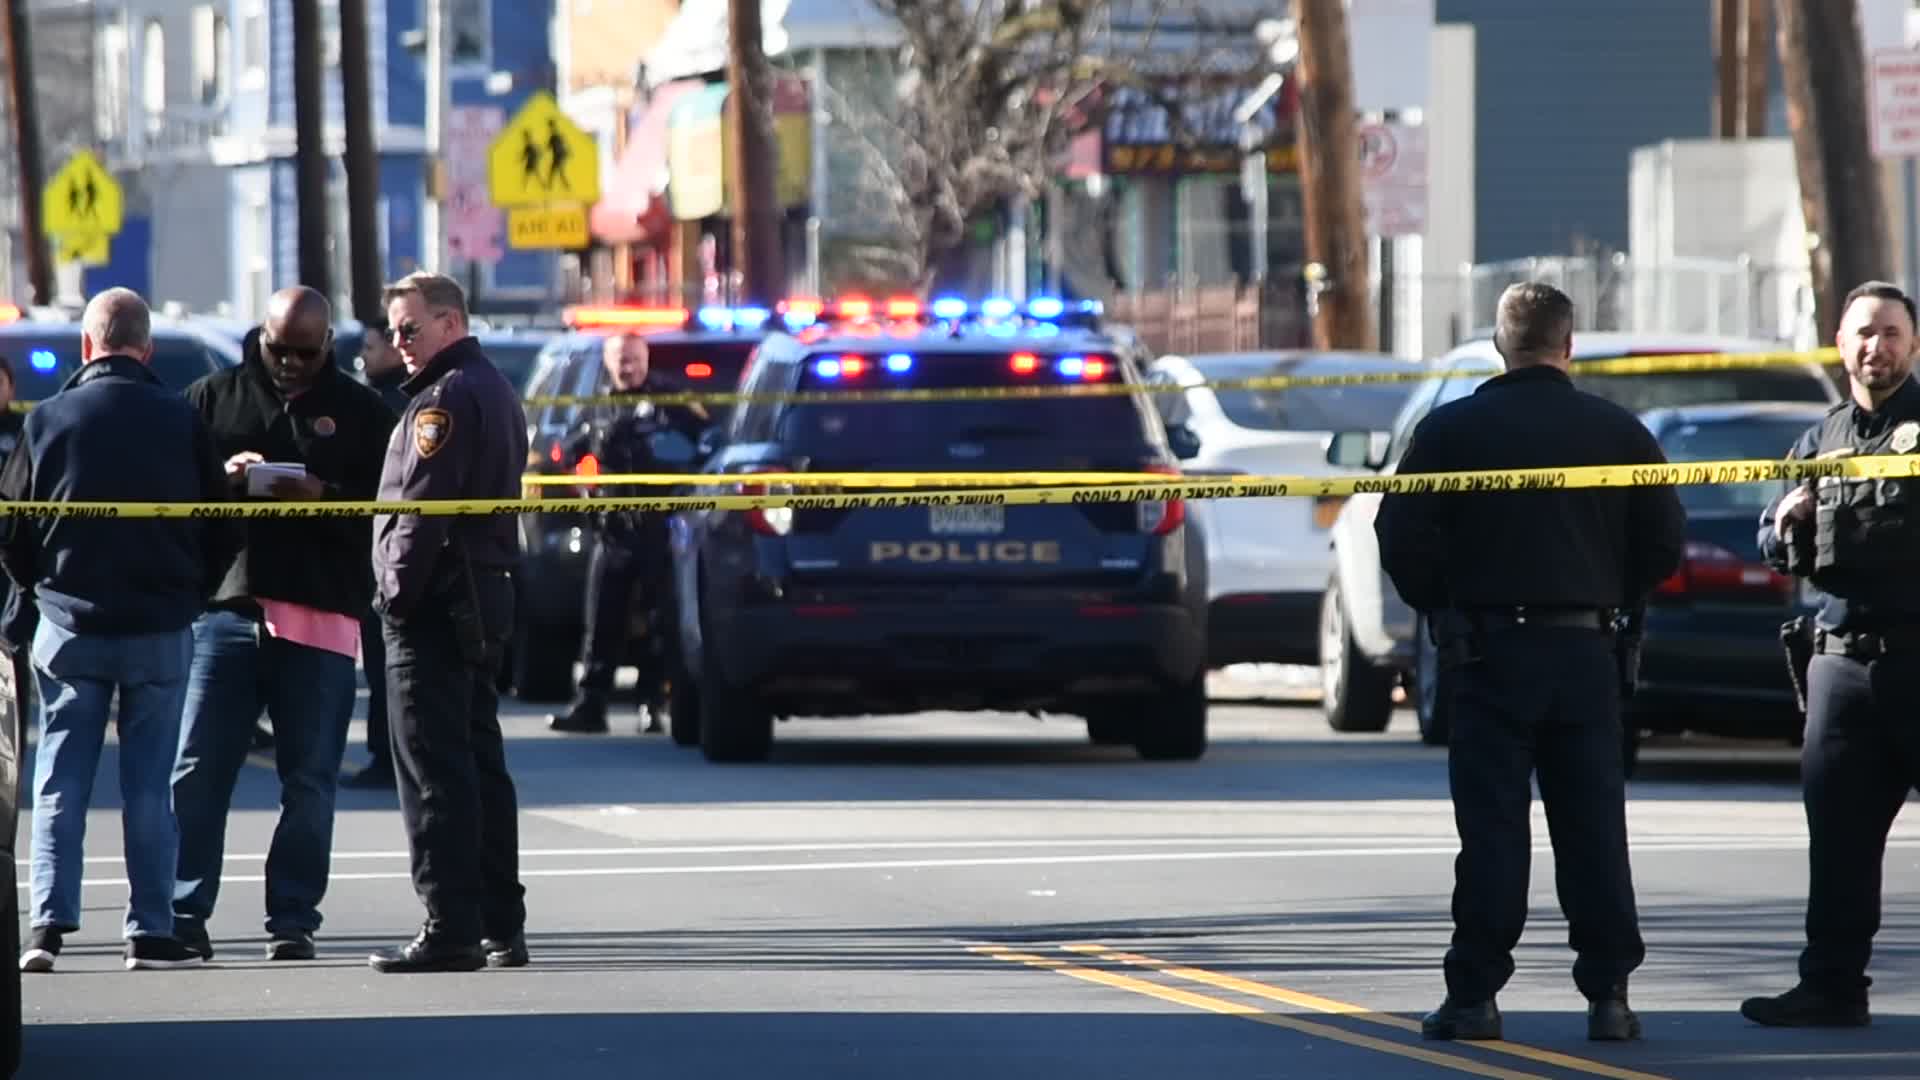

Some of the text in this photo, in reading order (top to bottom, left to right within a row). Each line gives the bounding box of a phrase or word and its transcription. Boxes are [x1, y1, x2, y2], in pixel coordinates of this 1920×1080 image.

[1353, 472, 1566, 494] CRIME SCENE DO NOT CROSS
[1631, 463, 1843, 486] CRIME SCENE DO NOT CROSS
[870, 541, 1060, 562] POLICE
